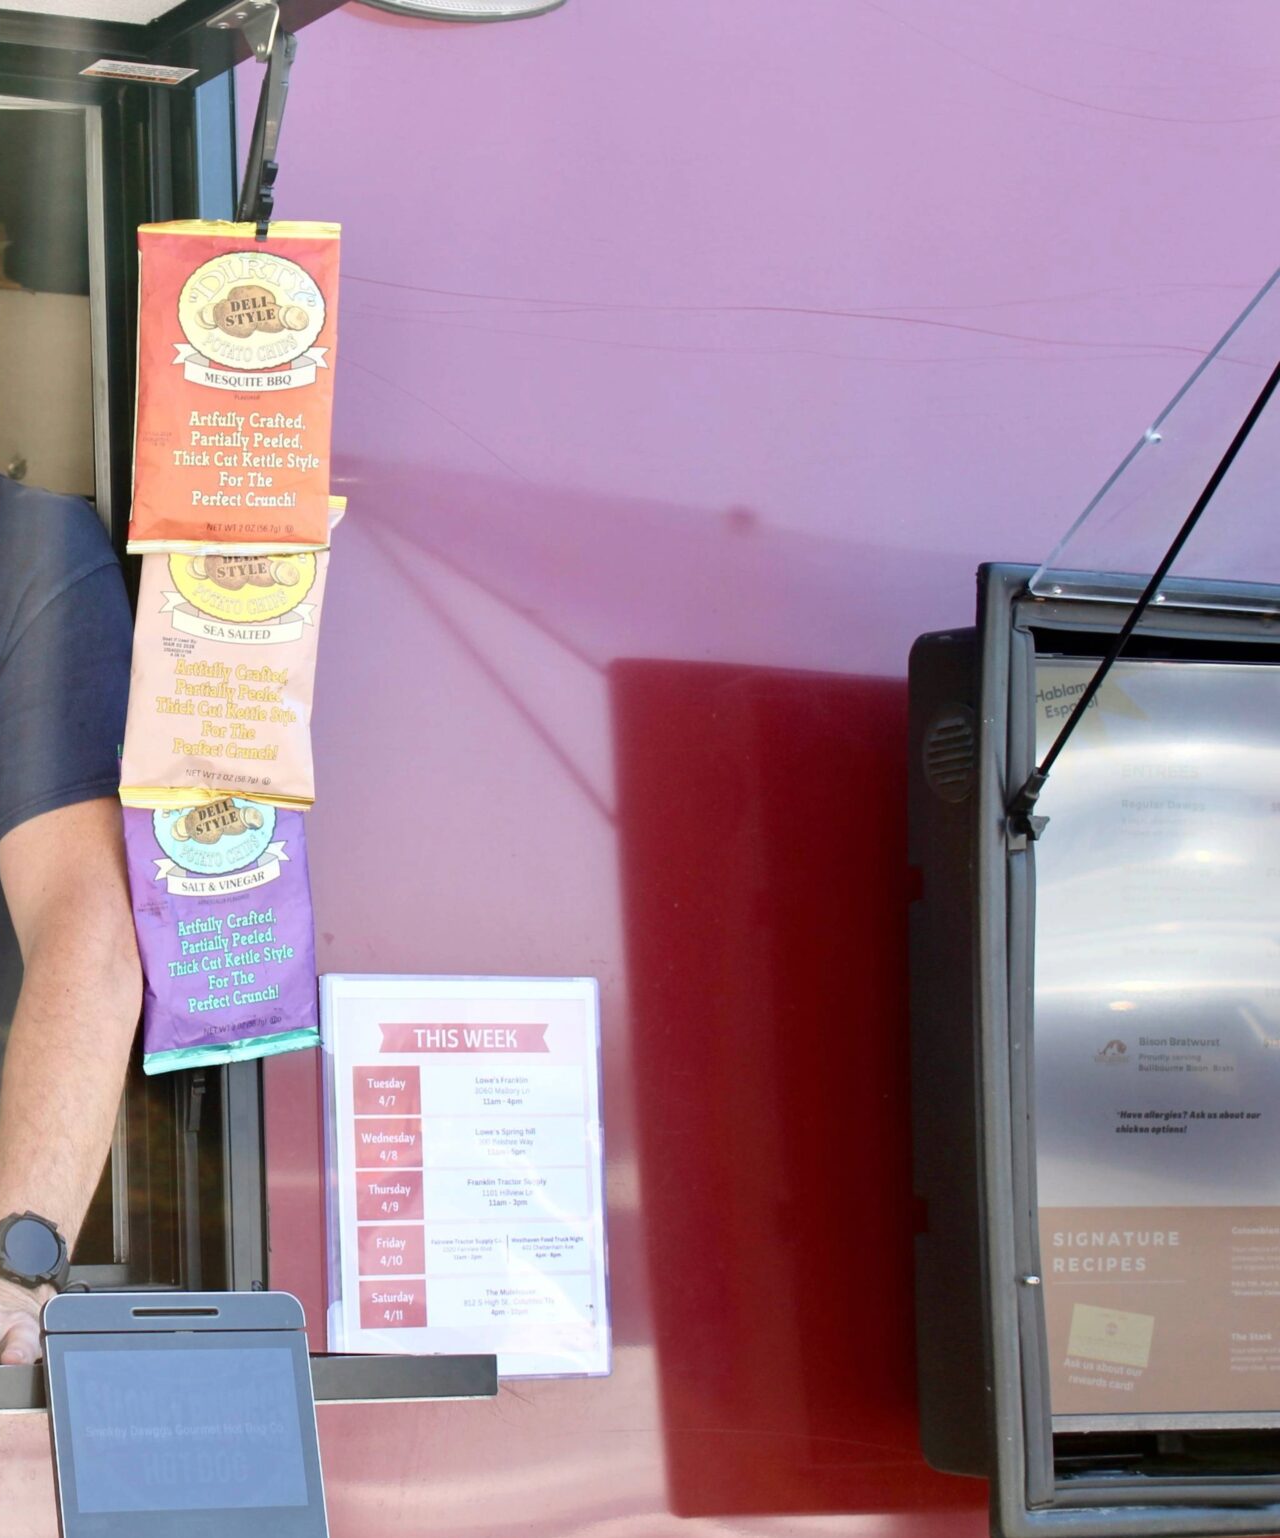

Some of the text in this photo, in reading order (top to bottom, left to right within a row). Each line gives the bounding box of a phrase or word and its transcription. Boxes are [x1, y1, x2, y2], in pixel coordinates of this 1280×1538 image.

[230, 296, 270, 312] DELI
[225, 308, 276, 326] STYLE
[202, 333, 298, 363] POTATO CHIPS
[204, 372, 292, 387] MESQUITE BBQ
[189, 411, 305, 431] Artfully Crafted,
[191, 431, 249, 450] Partially
[253, 433, 303, 449] Peeled,
[173, 451, 319, 472] Thick Cut Kettle Style
[219, 472, 273, 487] For The
[192, 491, 296, 507] Perfect Crunch!
[217, 563, 267, 578] STYLE
[193, 584, 288, 615] POTATO CHIPS
[203, 625, 271, 639] SEA SALTED
[175, 659, 289, 685] Artfully Crafted,
[175, 680, 234, 702] Partially
[1035, 680, 1103, 703] Hablams
[156, 697, 297, 726] Thick Cut Kettle Style
[202, 722, 256, 739] For The
[173, 739, 279, 760] Perfect Crunch!
[198, 800, 231, 821] DELI
[196, 811, 238, 835] STYLE
[182, 871, 265, 892] SALT & VINEGAR
[177, 907, 277, 937] Artfully Crafted,
[181, 928, 276, 955] Partially Peeled,
[168, 944, 294, 977] Thick Cut Kettle Style
[208, 970, 256, 990] For The
[188, 984, 279, 1013] Perfect Crunch!
[414, 1029, 518, 1048] THIS WEEK
[1139, 1037, 1220, 1047] Bison Bratwurst
[367, 1078, 406, 1090] Tuesday
[379, 1095, 396, 1107] 4/7
[1144, 1110, 1188, 1121] allergies?
[1190, 1110, 1205, 1119] Ask
[1218, 1110, 1244, 1119] about
[361, 1132, 415, 1145] Wednesday
[501, 1128, 524, 1136] Spring
[1115, 1125, 1188, 1135] chicken options!
[380, 1150, 398, 1161] 4/8
[369, 1184, 411, 1197] Thursday
[381, 1201, 399, 1212] 4/9
[376, 1238, 406, 1250] Friday
[1053, 1232, 1180, 1246] SIGNATURE
[380, 1255, 403, 1266] 4/10
[1053, 1258, 1147, 1272] RECIPES
[372, 1292, 414, 1304] Saturday
[383, 1309, 403, 1321] 4/11
[1064, 1358, 1143, 1376] Ask us about our
[1068, 1374, 1134, 1391] rewards card!
